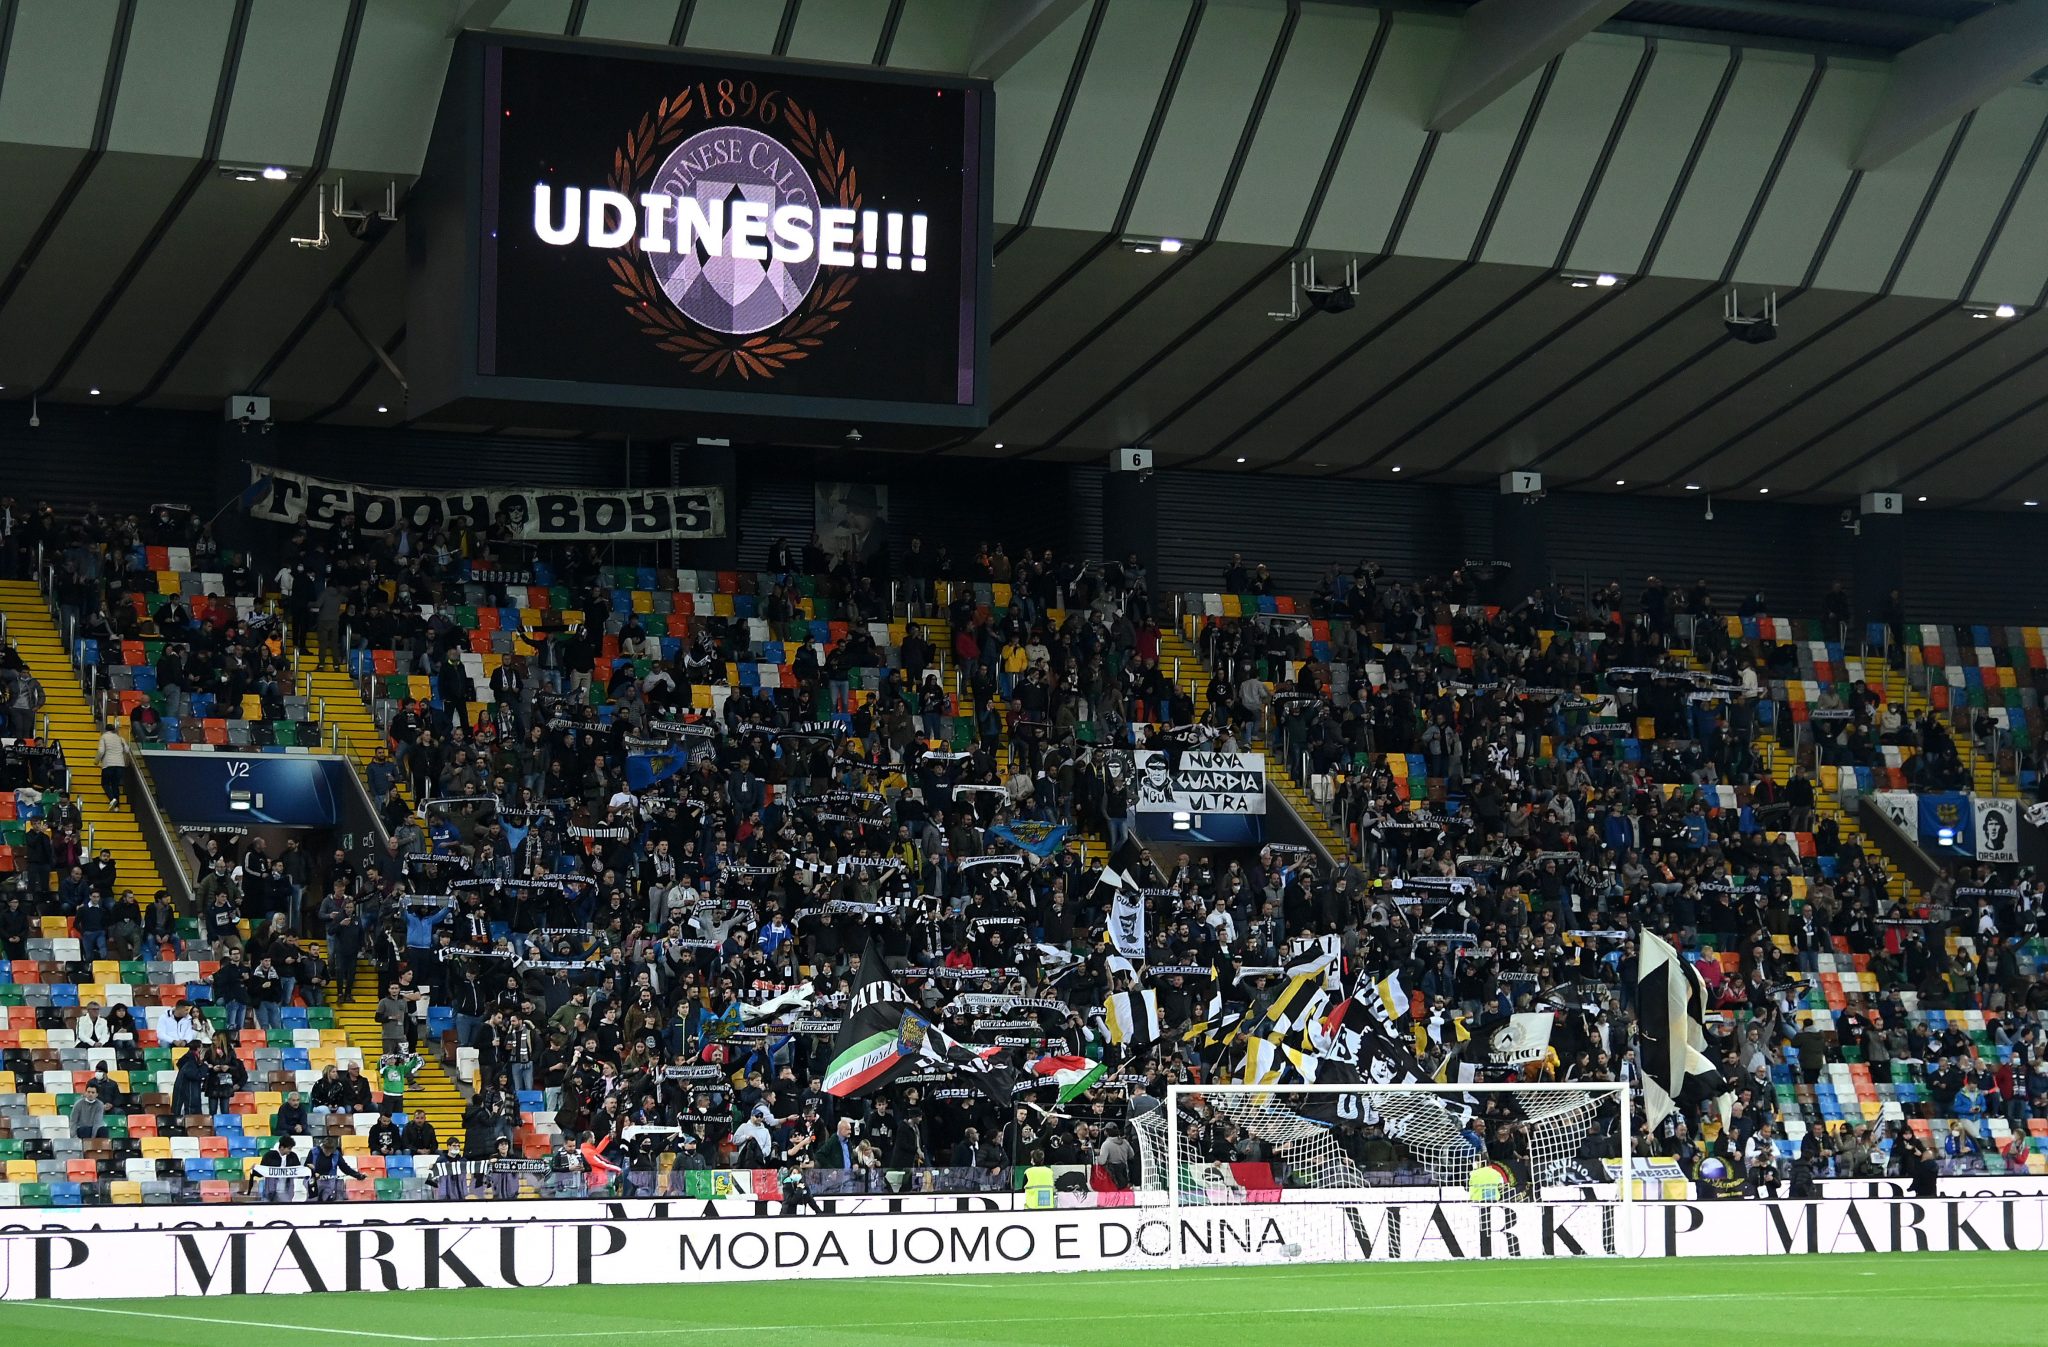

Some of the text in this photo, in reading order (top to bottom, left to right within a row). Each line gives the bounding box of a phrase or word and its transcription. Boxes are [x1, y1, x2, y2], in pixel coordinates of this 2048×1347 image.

[698, 79, 782, 125] 1896
[534, 184, 928, 272] UDINESE!!!
[246, 402, 256, 416] 4
[1132, 453, 1142, 467] 6
[1523, 477, 1531, 488] 7
[267, 477, 714, 536] TEDDY BOYS
[1884, 496, 1892, 510] 8
[227, 761, 250, 777] V2
[1189, 753, 1245, 769] NUOVA
[1176, 772, 1260, 791] GUARDIA
[1189, 793, 1248, 811] ULTRA
[1012, 998, 1060, 1009] UDINESE
[981, 1019, 1002, 1027] forza
[862, 1039, 894, 1072] Nord
[1610, 1168, 1681, 1178] TMEZZO
[1341, 1202, 1704, 1261] MARKUP
[680, 1216, 1286, 1270] MODA UOMO E DONNA
[164, 1223, 628, 1297] MARKUP
